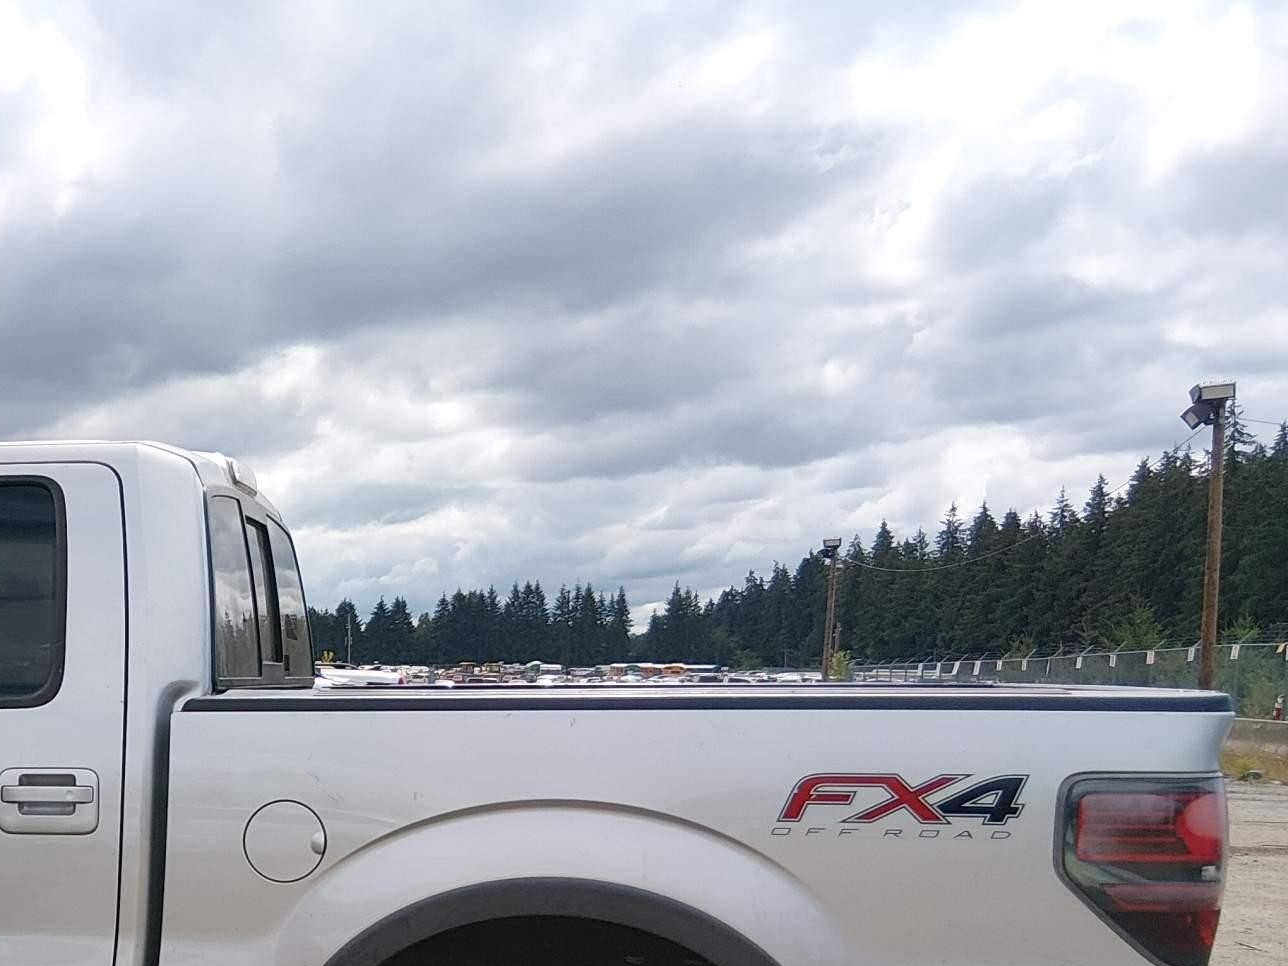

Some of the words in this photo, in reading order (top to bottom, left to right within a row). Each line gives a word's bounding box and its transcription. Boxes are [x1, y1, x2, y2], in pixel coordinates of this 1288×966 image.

[775, 772, 1031, 826] FX4
[770, 827, 859, 837] OFF
[884, 828, 1012, 840] ROAD
